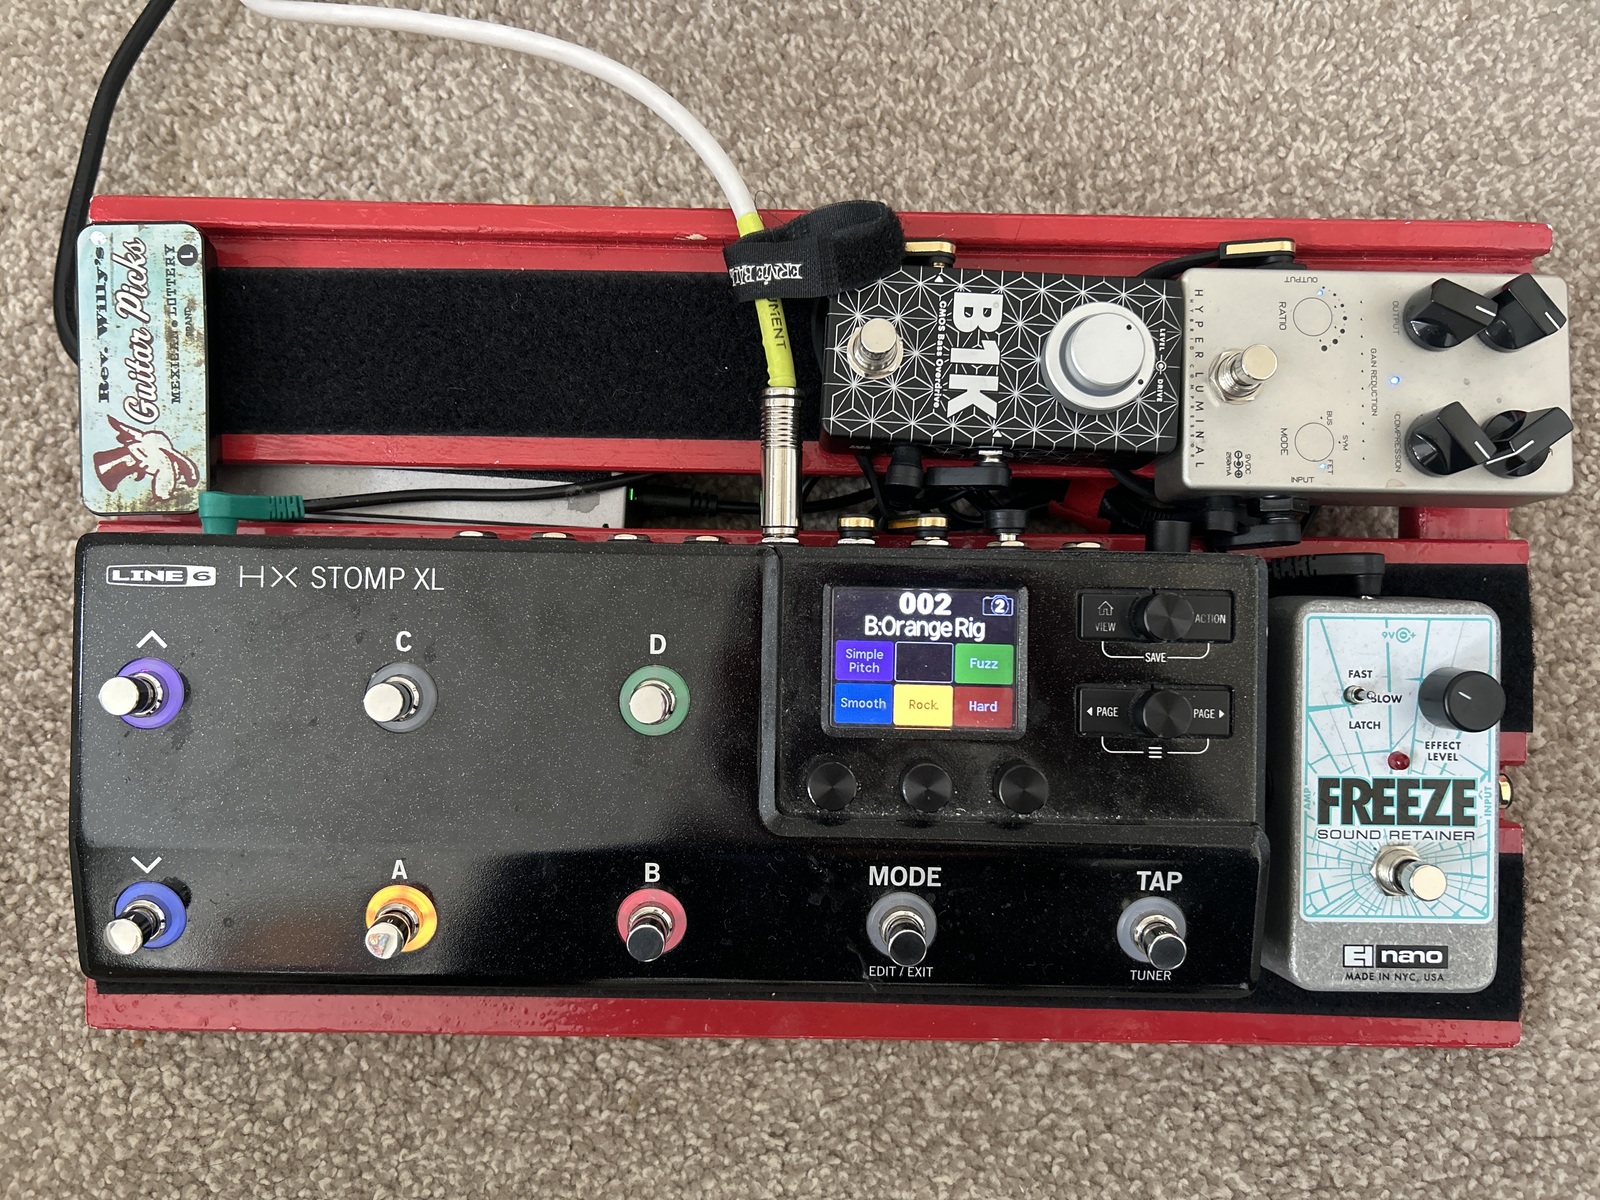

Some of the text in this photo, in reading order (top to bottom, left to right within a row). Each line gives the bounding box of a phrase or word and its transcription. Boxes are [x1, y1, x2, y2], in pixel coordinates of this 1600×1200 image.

[755, 262, 803, 286] ERNIE
[94, 246, 110, 403] Rev. Willy's
[164, 243, 181, 404] MEXICAN LOTTERY
[183, 306, 193, 337] BRAND
[1278, 301, 1287, 331] RATIO
[1392, 300, 1400, 335] OUTPUT
[111, 237, 160, 425] Guitar Picks
[933, 300, 947, 409] CMOS Bass Overdrive
[947, 292, 1003, 419] B1K
[1156, 379, 1164, 403] DRIVE
[1370, 369, 1378, 417] REDUCTION
[1280, 427, 1288, 456] MODE
[1393, 414, 1402, 473] COMPRESSION
[112, 568, 212, 582] LINE 6
[239, 565, 445, 590] HX STOMP XL
[898, 592, 952, 616] 002
[993, 598, 1006, 614] 2
[864, 615, 986, 643] B:Orange Rig
[1095, 622, 1117, 632] VIEW
[1194, 613, 1226, 624] ACTION
[395, 630, 413, 652] C
[650, 633, 667, 655] D
[1382, 631, 1395, 639] 9V
[845, 648, 884, 662] Simple
[969, 657, 999, 670] Fuzz
[1144, 652, 1167, 663] SAVE
[849, 662, 880, 674] Pitch
[1348, 669, 1373, 679] FAST
[840, 697, 887, 710] Smooth
[908, 699, 938, 711] Rock
[969, 700, 998, 713] Hard
[1096, 706, 1119, 717] PAGE
[1193, 708, 1216, 719] PAGE
[1348, 720, 1381, 730] LATCH
[1424, 741, 1462, 751] EFFECT
[1427, 752, 1459, 762] LEVEL
[1303, 787, 1312, 810] AMP
[1316, 776, 1478, 827] FREEZE
[1483, 786, 1492, 817] INPUT
[1317, 829, 1476, 841] SOUND RETAINER
[391, 859, 409, 880] A
[644, 862, 661, 883] B
[868, 865, 942, 887] MODE
[1136, 870, 1183, 892] TAP
[1381, 949, 1443, 964] nano
[868, 965, 897, 977] EDIT
[907, 966, 934, 978] EXIT
[1129, 969, 1172, 981] TUNER
[1345, 972, 1444, 982] MADE IN NYC, USA
